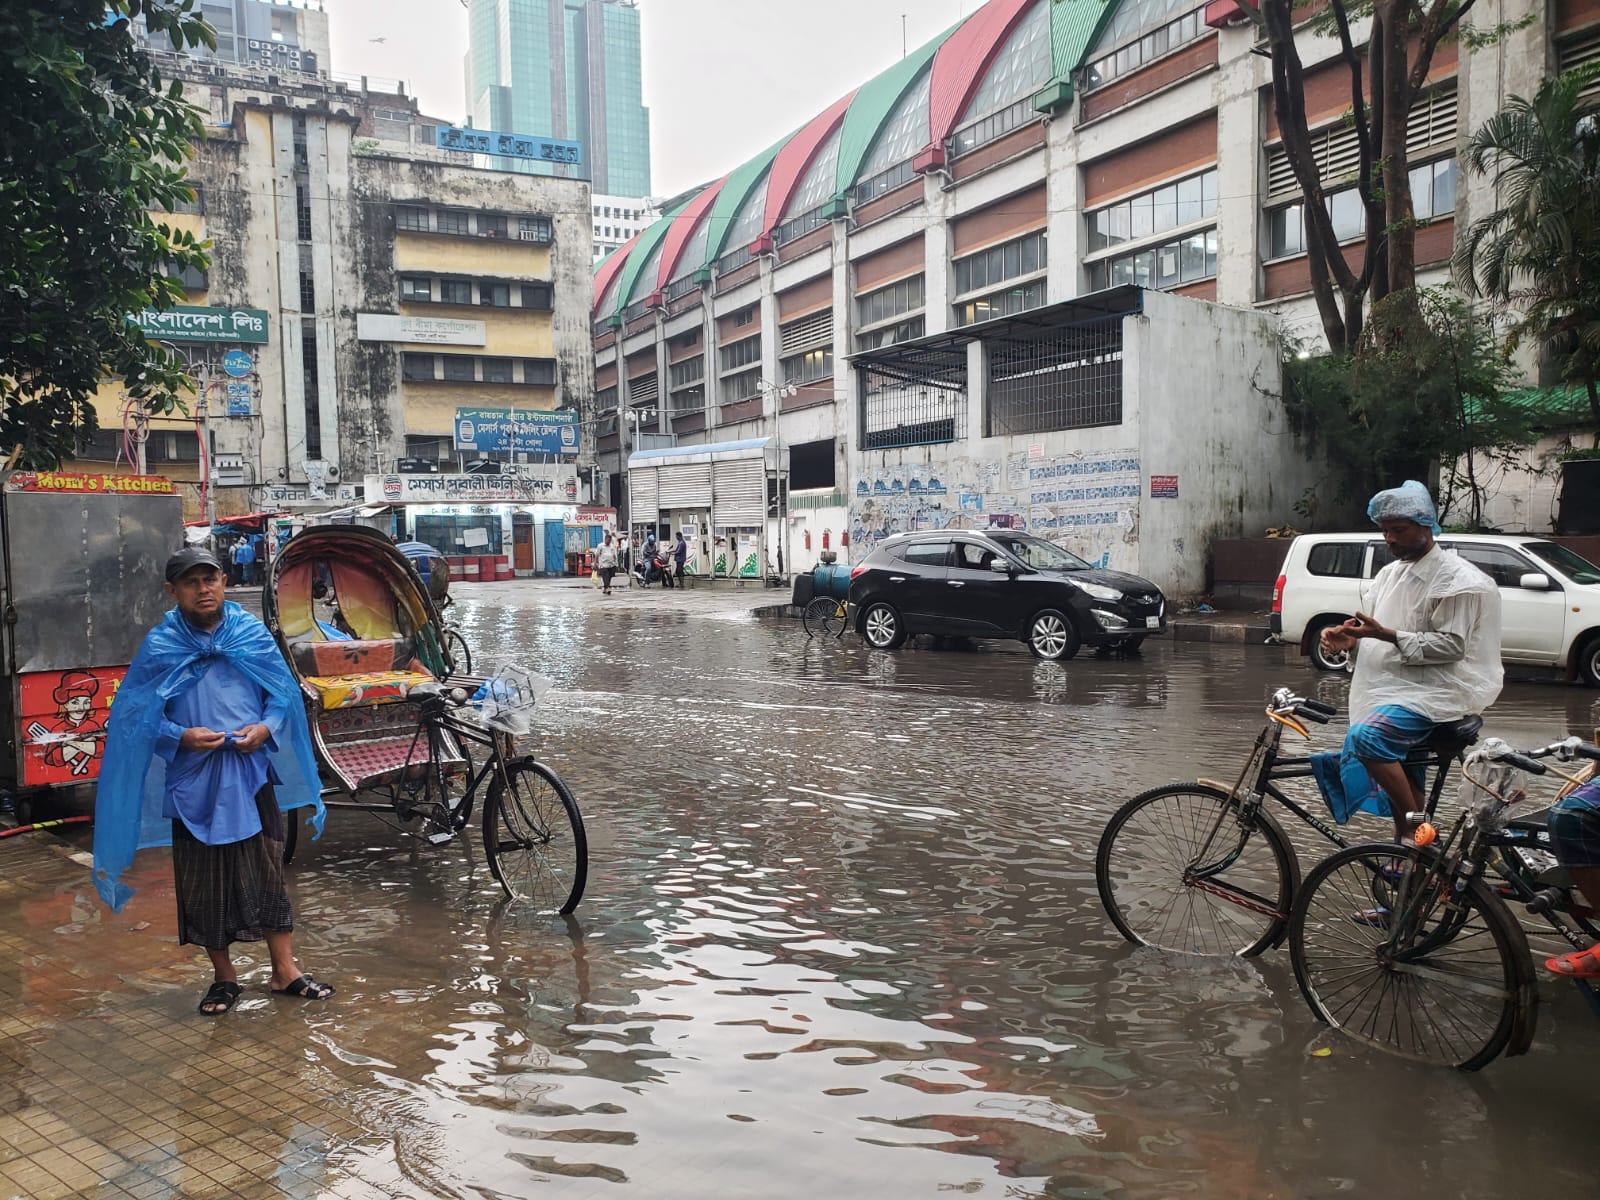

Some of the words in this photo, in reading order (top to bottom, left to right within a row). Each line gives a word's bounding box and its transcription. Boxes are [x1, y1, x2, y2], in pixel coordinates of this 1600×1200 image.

[441, 129, 490, 152] জীবন
[498, 135, 533, 156] বীমা
[541, 143, 578, 161] ভবন
[230, 311, 263, 332] লিঃ
[36, 472, 97, 490] Mom's
[102, 475, 172, 492] Kitchen
[408, 475, 444, 492] মেসার্স
[1306, 815, 1340, 841] NEELAM
